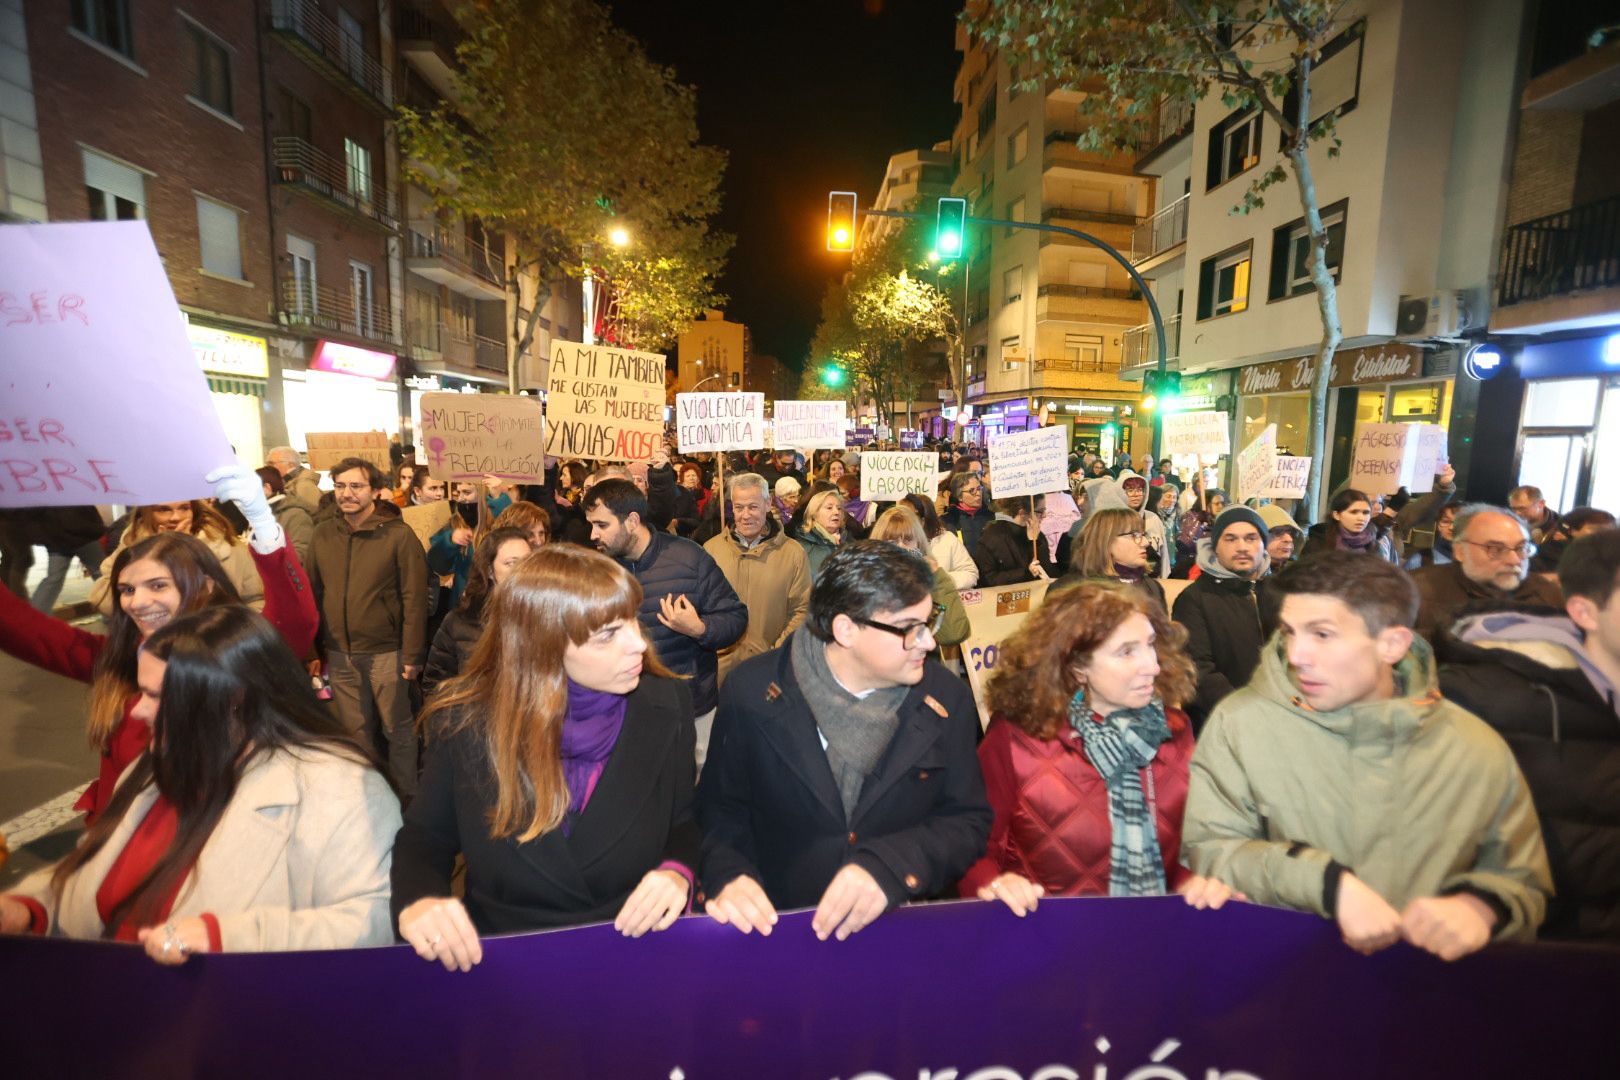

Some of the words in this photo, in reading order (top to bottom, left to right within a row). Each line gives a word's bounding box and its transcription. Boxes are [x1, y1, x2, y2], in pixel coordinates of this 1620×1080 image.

[552, 347, 566, 373] A
[606, 352, 664, 385] TAMBIÉN
[550, 379, 567, 393] ME
[572, 381, 618, 398] GUSTAN
[574, 399, 597, 414] LAS
[604, 399, 663, 421] MUJERES
[682, 395, 755, 419] VIOLENCIA
[432, 408, 487, 433] MUJER
[545, 419, 560, 453] Y
[560, 420, 587, 455] NO
[587, 423, 615, 457] LAS
[614, 428, 664, 460] ACOSO
[682, 419, 753, 446] ECONÓMICA
[444, 453, 540, 474] REVOLUCIÓN
[867, 454, 935, 474] VIOLENCIA
[1277, 458, 1306, 471] ENCIA
[0, 458, 141, 496] BRE
[868, 476, 930, 494] LABORAL
